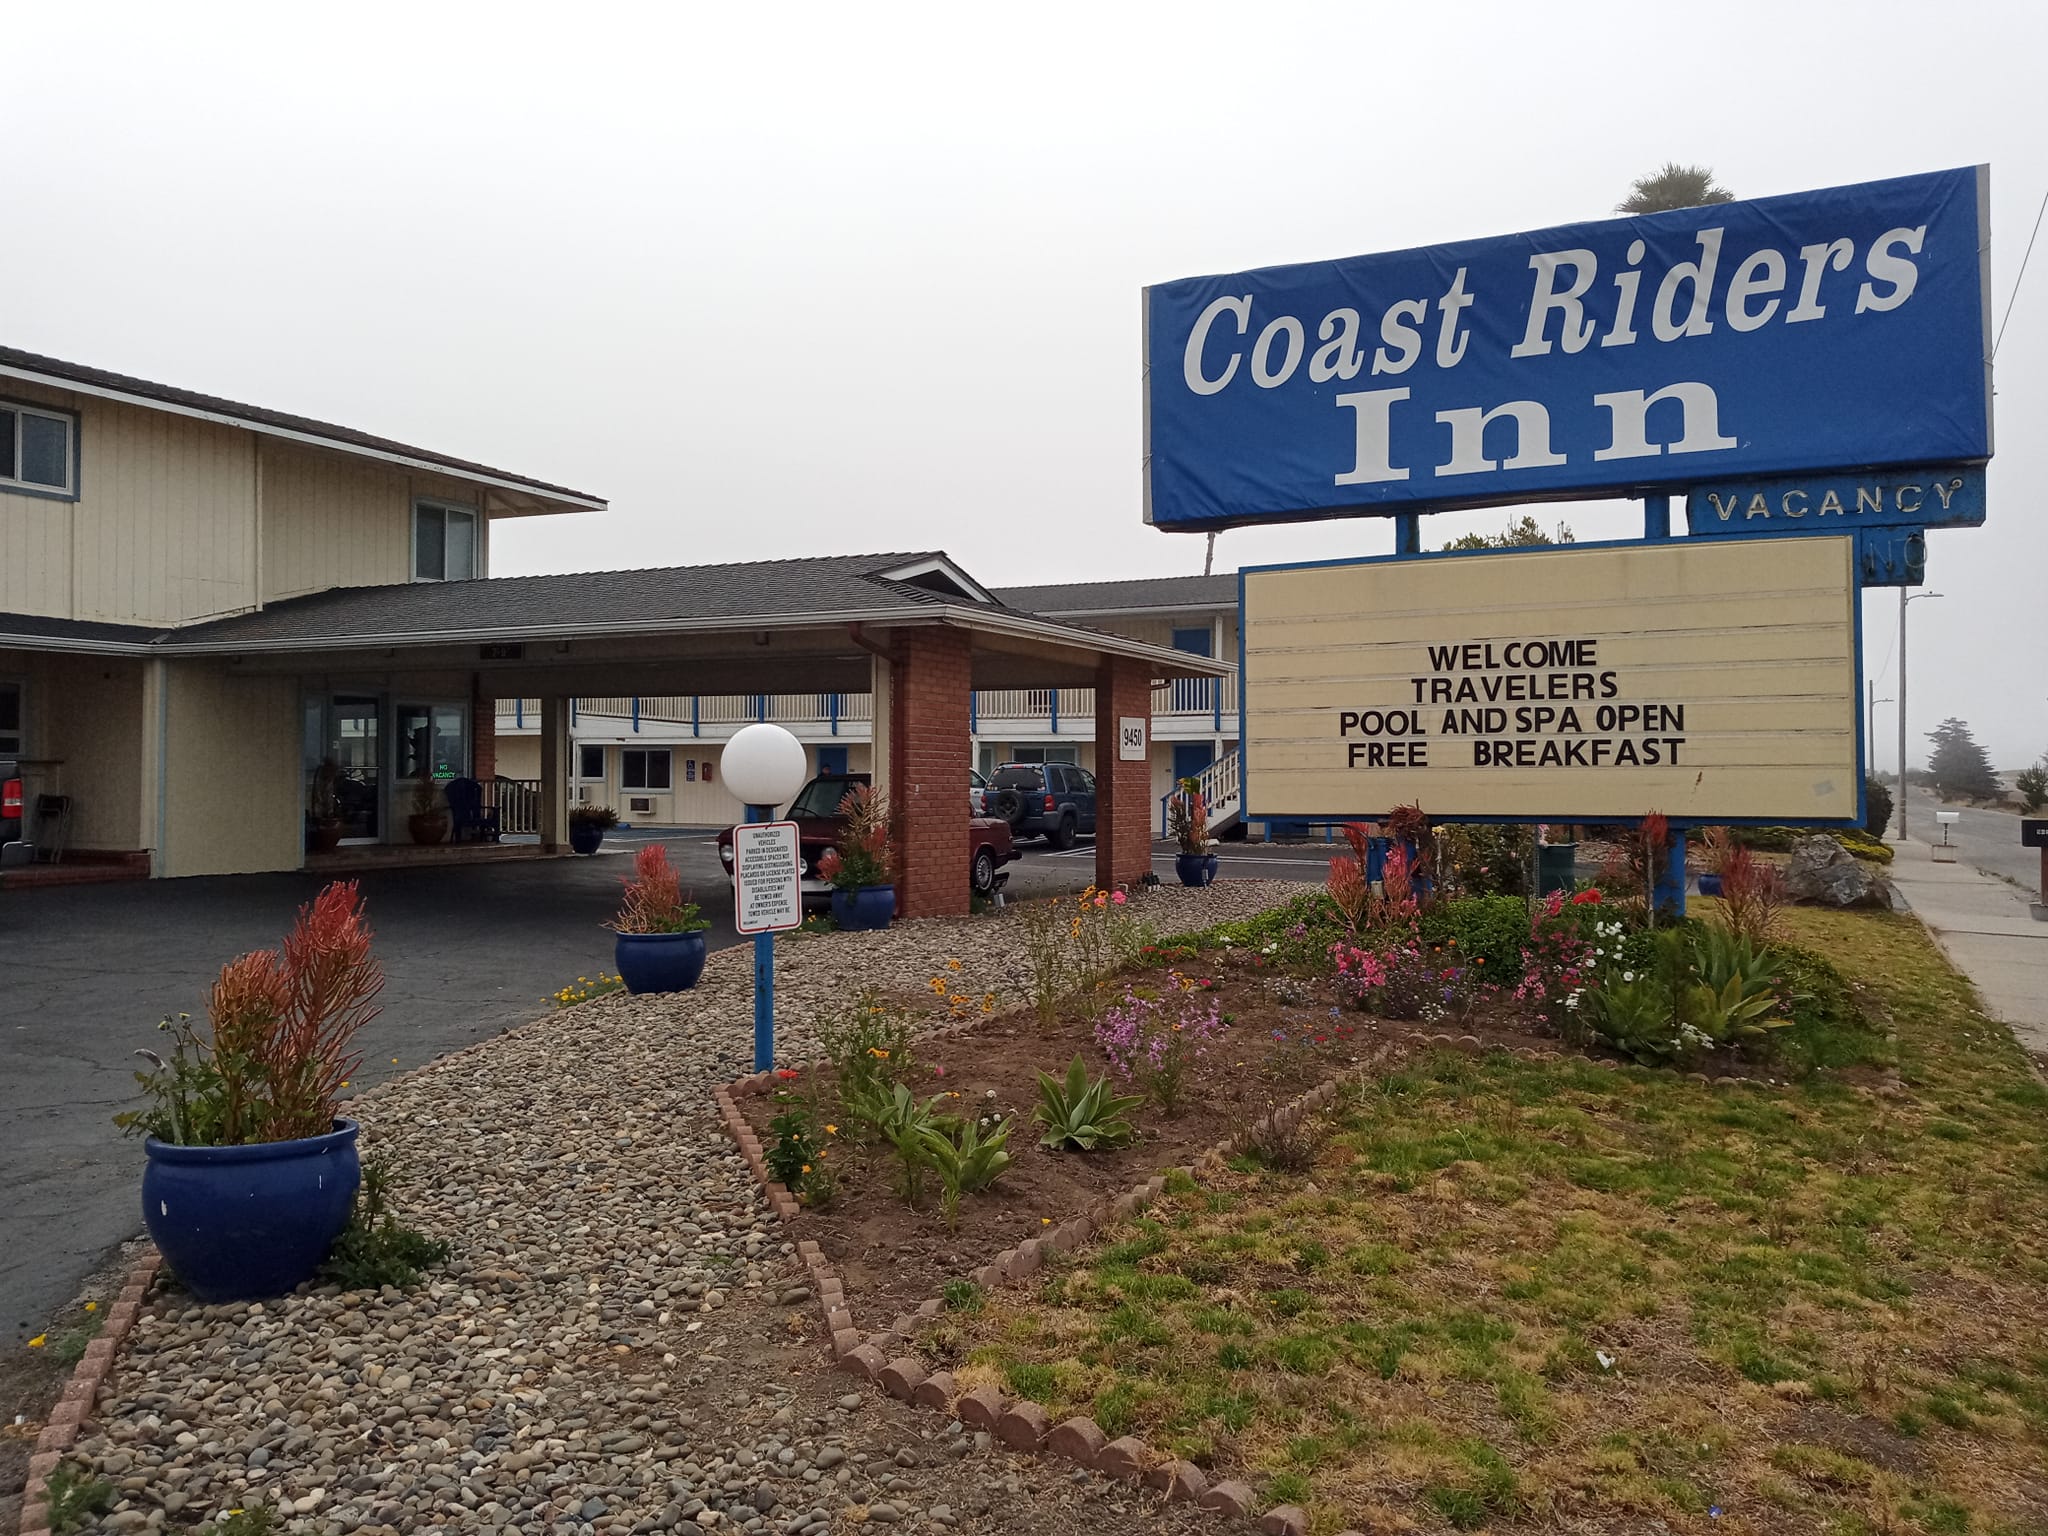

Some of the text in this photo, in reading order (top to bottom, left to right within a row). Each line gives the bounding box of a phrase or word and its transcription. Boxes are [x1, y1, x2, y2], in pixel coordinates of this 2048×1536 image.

[1182, 224, 1928, 396] Coast Riders
[1333, 379, 1738, 487] Inn
[1708, 479, 1963, 521] VACANCY
[1868, 534, 1928, 572] NO
[1427, 639, 1597, 672] WELCOME
[1410, 671, 1618, 704] TRAVELERS
[1123, 727, 1142, 747] 9450
[1340, 704, 1685, 737] POOL AND SPA OPEN
[1348, 737, 1686, 768] FREE BREAKFAST
[766, 868, 780, 876] LICENSE
[766, 876, 783, 884] PERSONS
